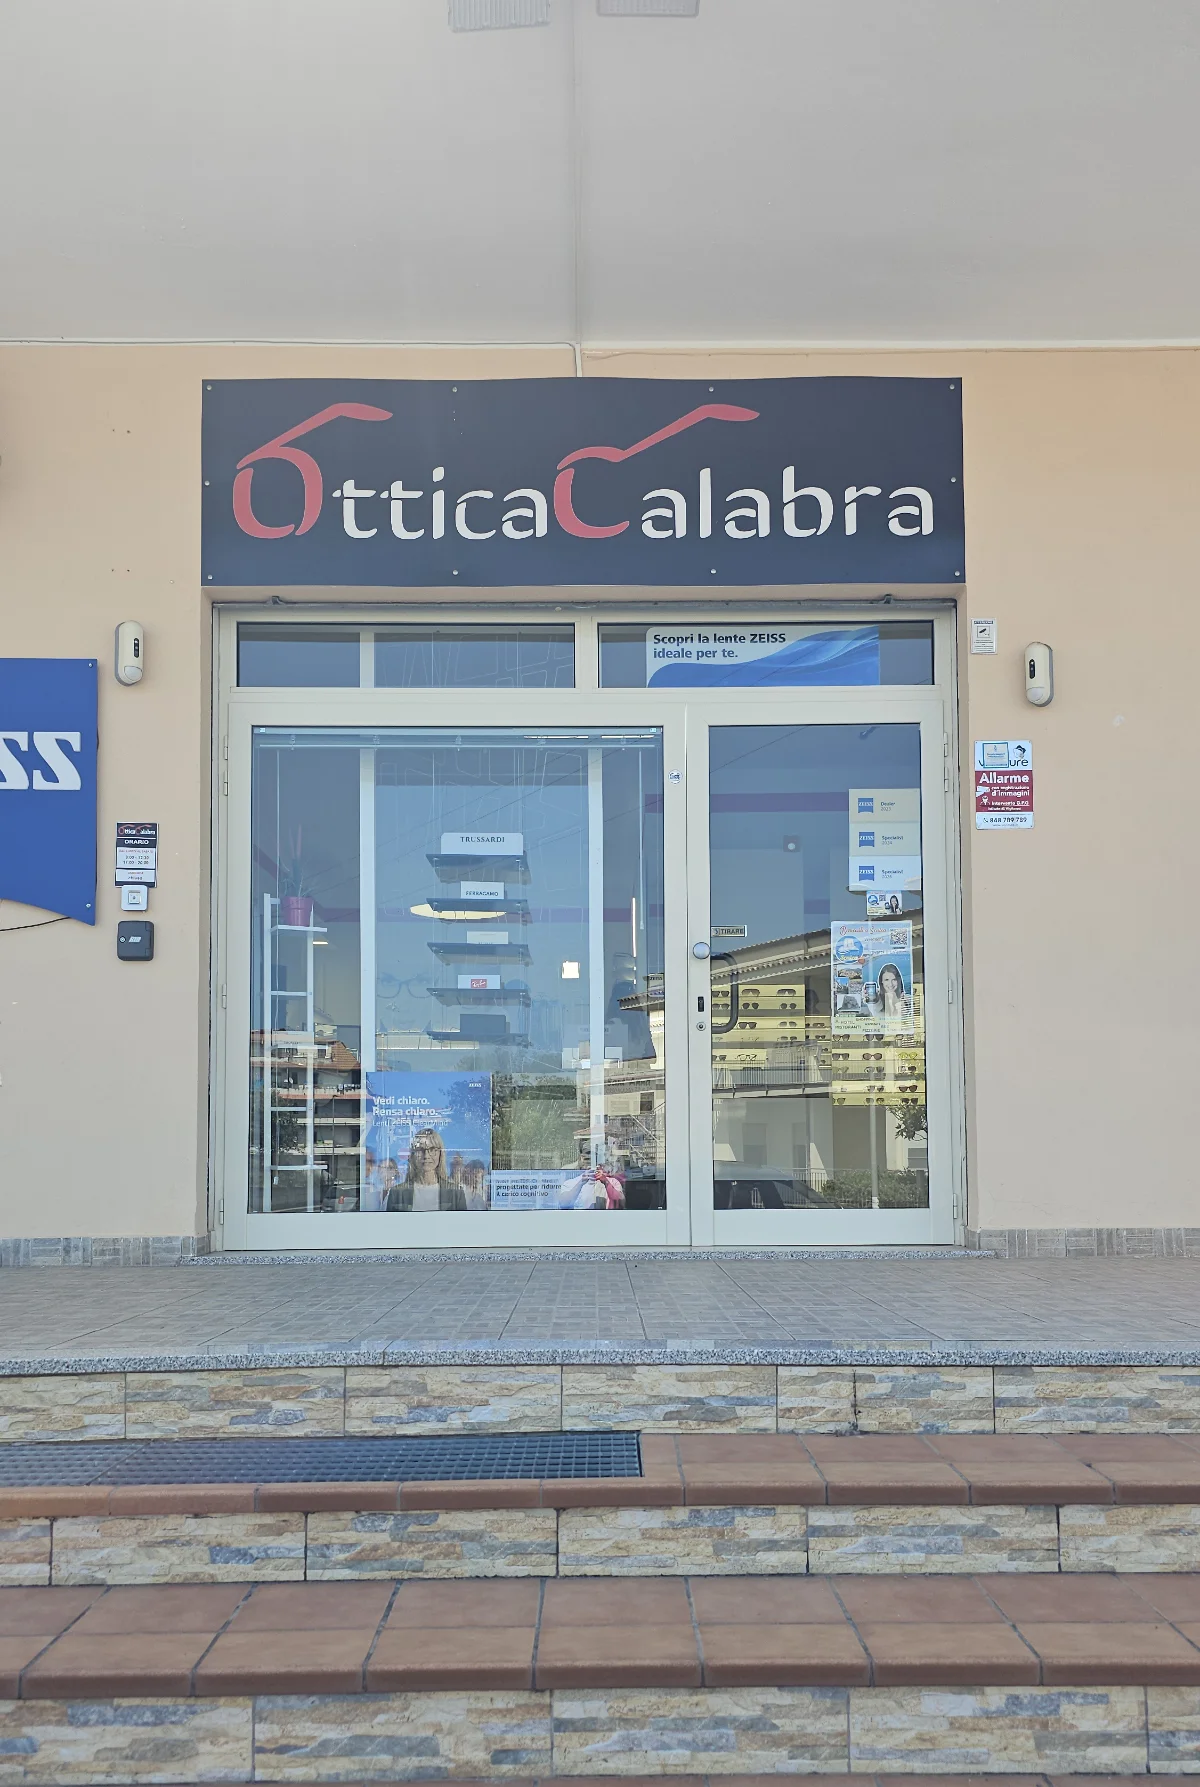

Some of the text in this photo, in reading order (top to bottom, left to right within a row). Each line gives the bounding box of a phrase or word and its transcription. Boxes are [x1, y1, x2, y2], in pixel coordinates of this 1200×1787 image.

[653, 633, 786, 646] Scopri la lente ZEISS
[653, 648, 738, 660] ideale per te.
[979, 772, 1030, 784] Allarme
[373, 1096, 430, 1105] Vedi chiaro.
[372, 1107, 438, 1116] Pensa chiaro.
